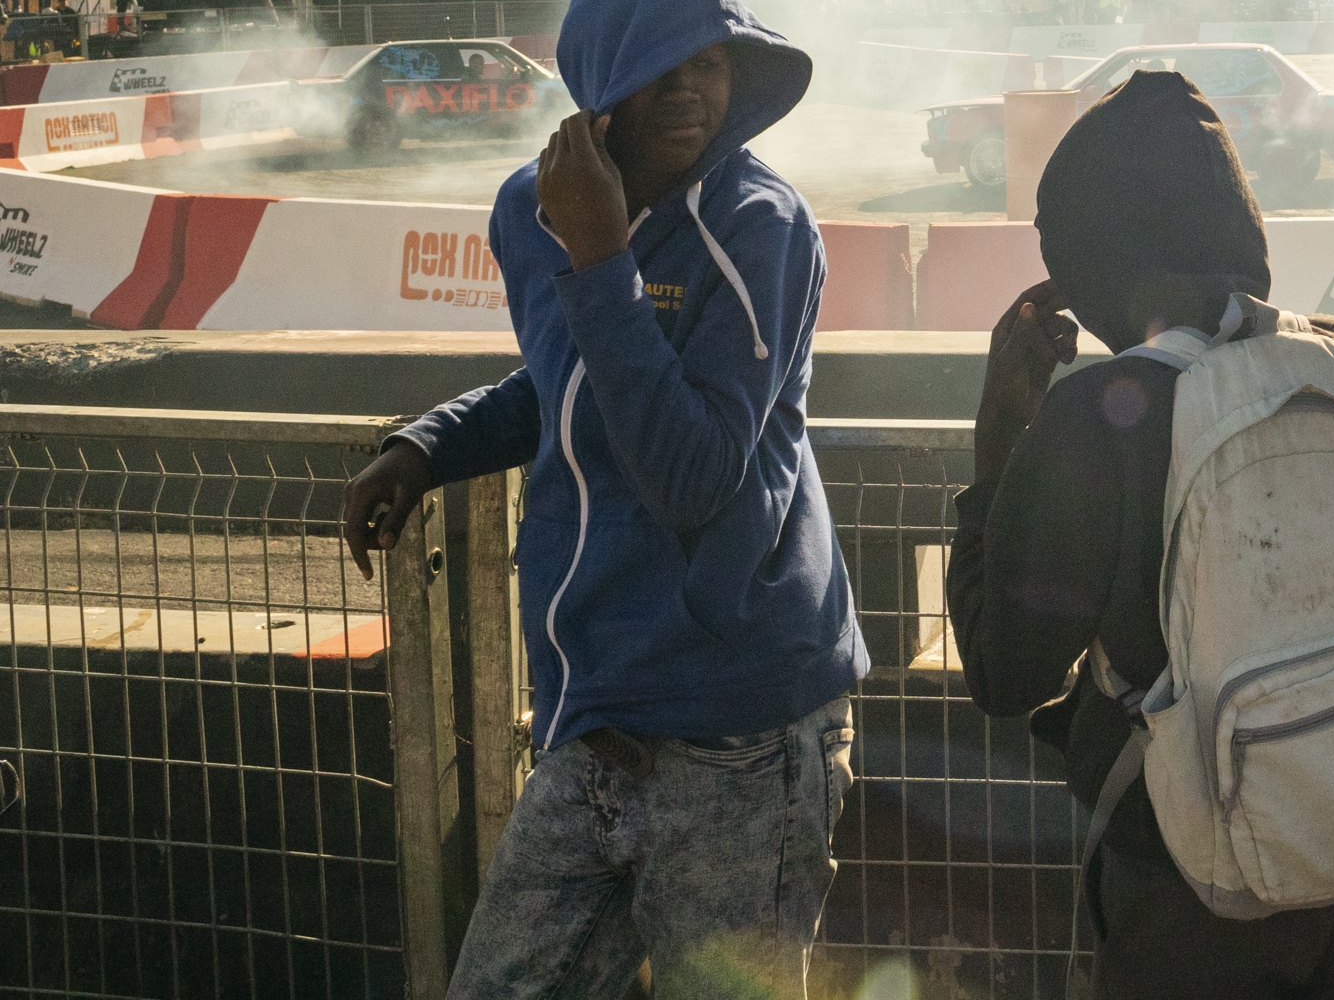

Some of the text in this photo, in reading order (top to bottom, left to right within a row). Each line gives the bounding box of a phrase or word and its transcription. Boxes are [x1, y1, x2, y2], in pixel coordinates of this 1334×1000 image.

[123, 75, 167, 90] WHEELZ
[384, 83, 536, 115] DAXIFLO
[0, 227, 48, 258] WHEELZ
[462, 233, 501, 281] NA
[644, 283, 687, 298] AUTE
